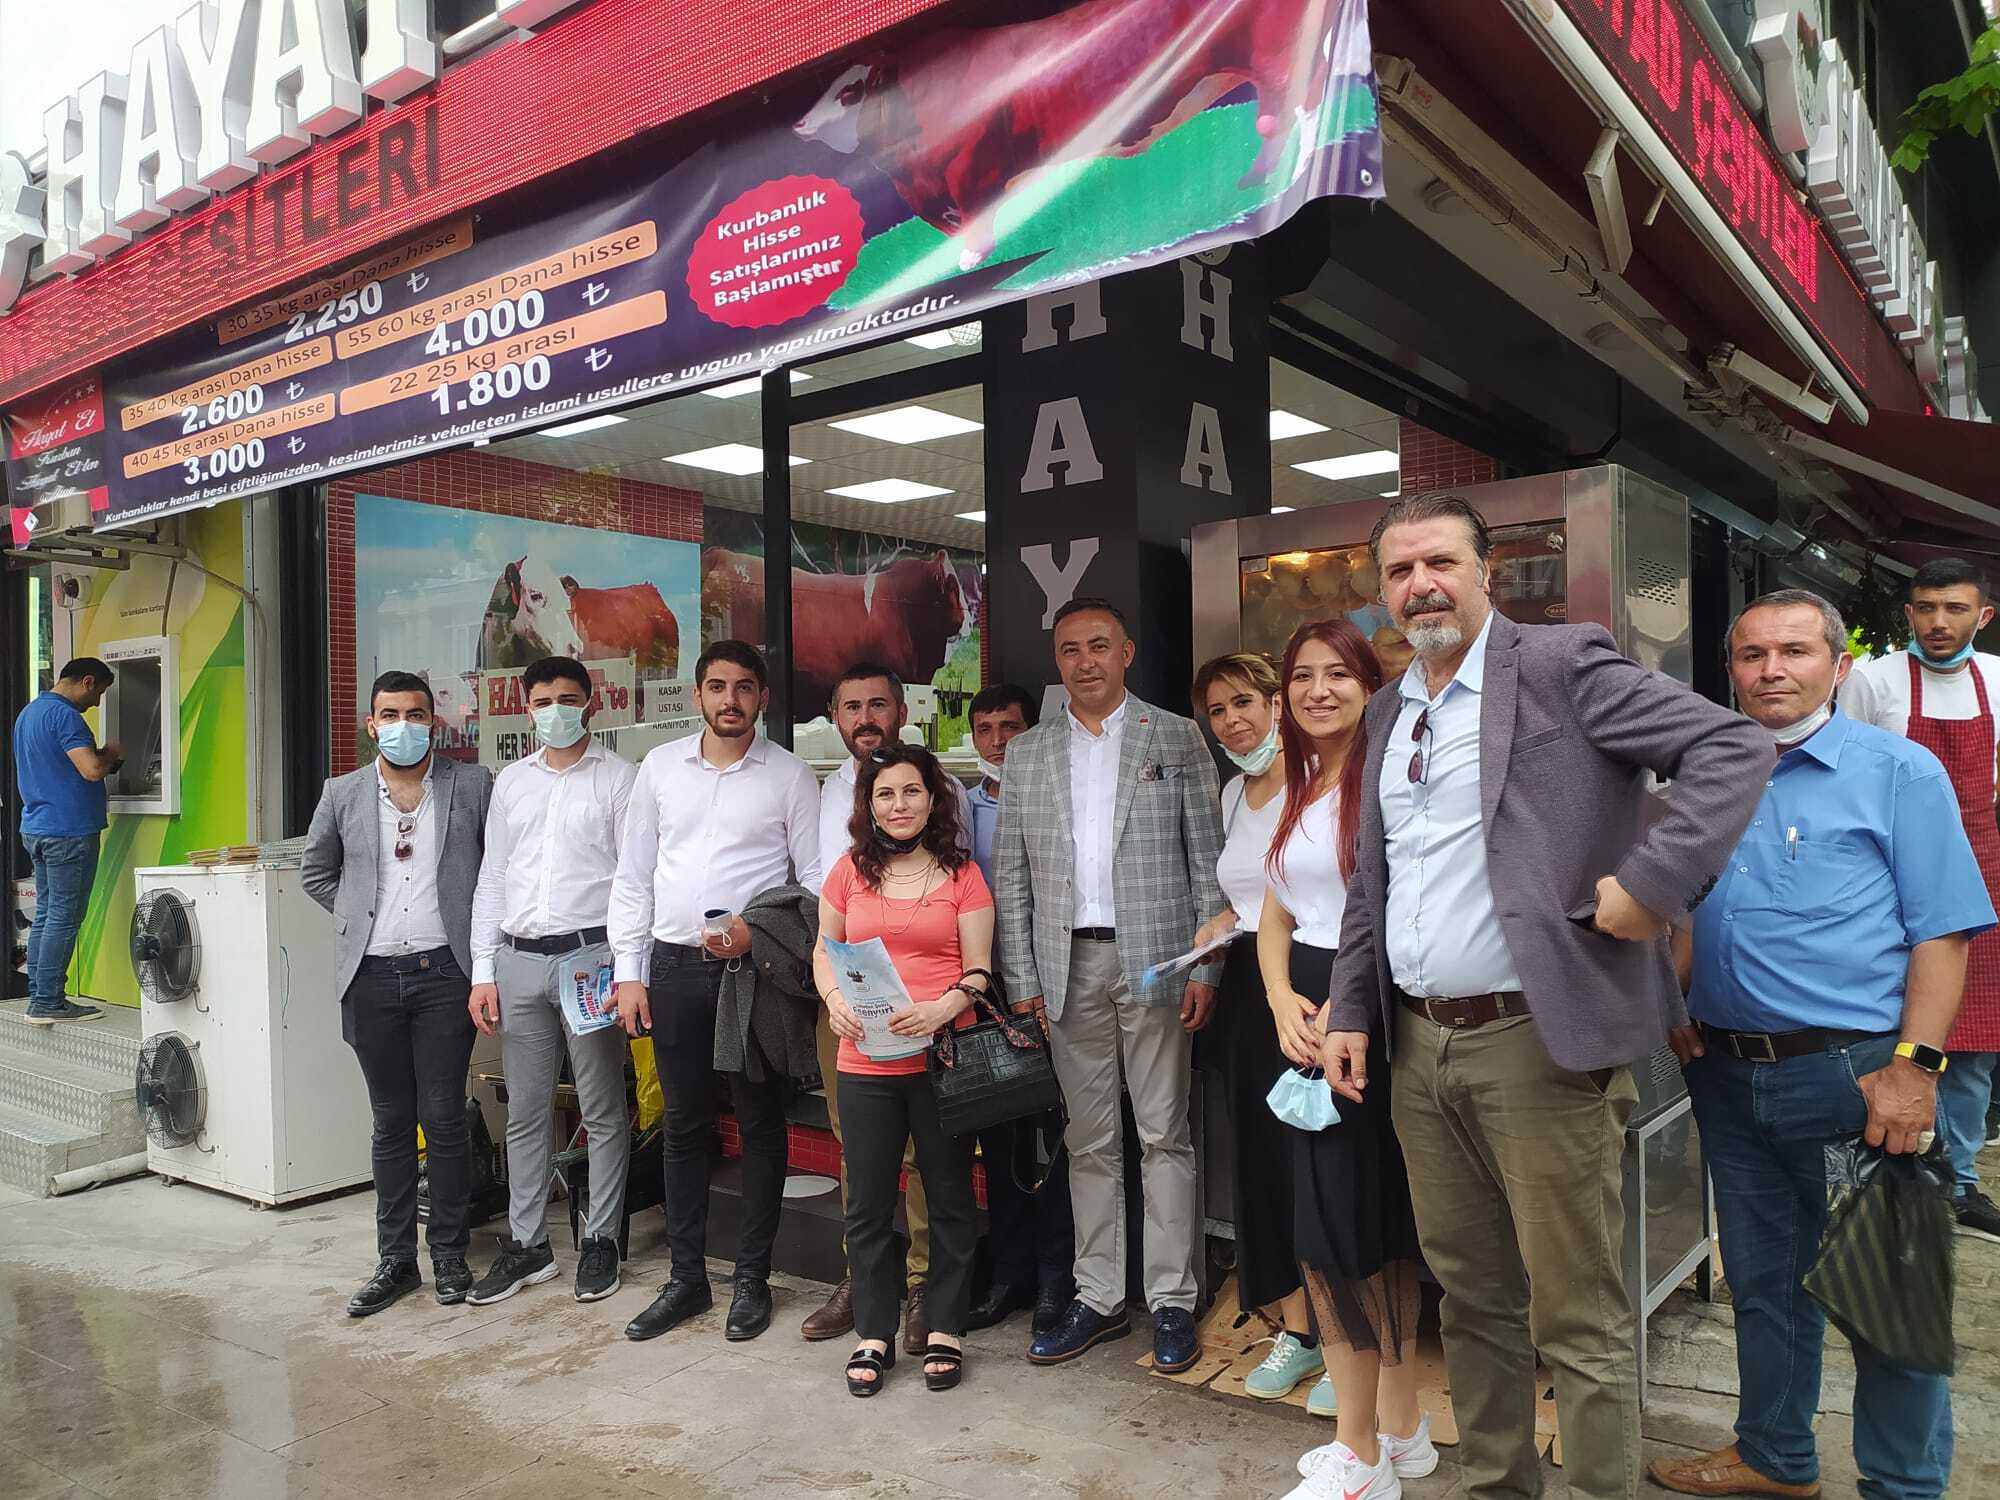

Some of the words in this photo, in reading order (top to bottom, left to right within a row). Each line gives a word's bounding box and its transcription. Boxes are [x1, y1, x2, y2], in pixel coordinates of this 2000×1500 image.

[717, 190, 827, 240] Kurbanlık
[743, 224, 801, 254] Hisse
[227, 316, 248, 334] 30
[253, 309, 274, 327] 35
[277, 297, 299, 316] kg
[303, 279, 346, 305] arası
[351, 259, 401, 287] Dana
[405, 231, 457, 260] hisse
[348, 329, 371, 348] 55
[378, 316, 404, 336] 60
[410, 307, 436, 328] kg
[441, 288, 493, 317] arası
[500, 261, 563, 295] Dana
[572, 232, 642, 270] hisse
[709, 234, 841, 287] Satışlarımız
[713, 259, 843, 307] Başlamıştır
[284, 281, 383, 344] 2.250
[424, 289, 545, 357] 4.000
[128, 403, 144, 421] 35
[147, 398, 167, 413] 40
[170, 391, 188, 408] kg
[191, 381, 227, 401] arası
[229, 363, 272, 386] Dana
[276, 346, 322, 369] hisse
[390, 372, 417, 395] 22
[427, 360, 457, 383] 25
[466, 349, 496, 372] kg
[506, 326, 576, 360] arası
[431, 353, 551, 416] 1.800
[104, 500, 168, 524] Kurbanlıklar
[169, 491, 200, 508] kendi
[203, 482, 228, 498] besi
[328, 435, 427, 468] kesimlerimiz
[432, 412, 516, 442] vekaleten
[521, 392, 582, 420] islami
[586, 370, 674, 404] usullere
[680, 350, 752, 380] uygun
[759, 293, 961, 363] yapılmaktadır.
[131, 453, 149, 468] 40
[153, 447, 170, 464] 45
[173, 442, 192, 458] kg
[194, 432, 230, 451] arası
[232, 415, 276, 437] Dana
[281, 400, 326, 424] hisse
[180, 383, 265, 435] 2.600
[183, 437, 265, 485] 3.000
[658, 686, 682, 696] KASAP
[658, 703, 683, 712] USTASI
